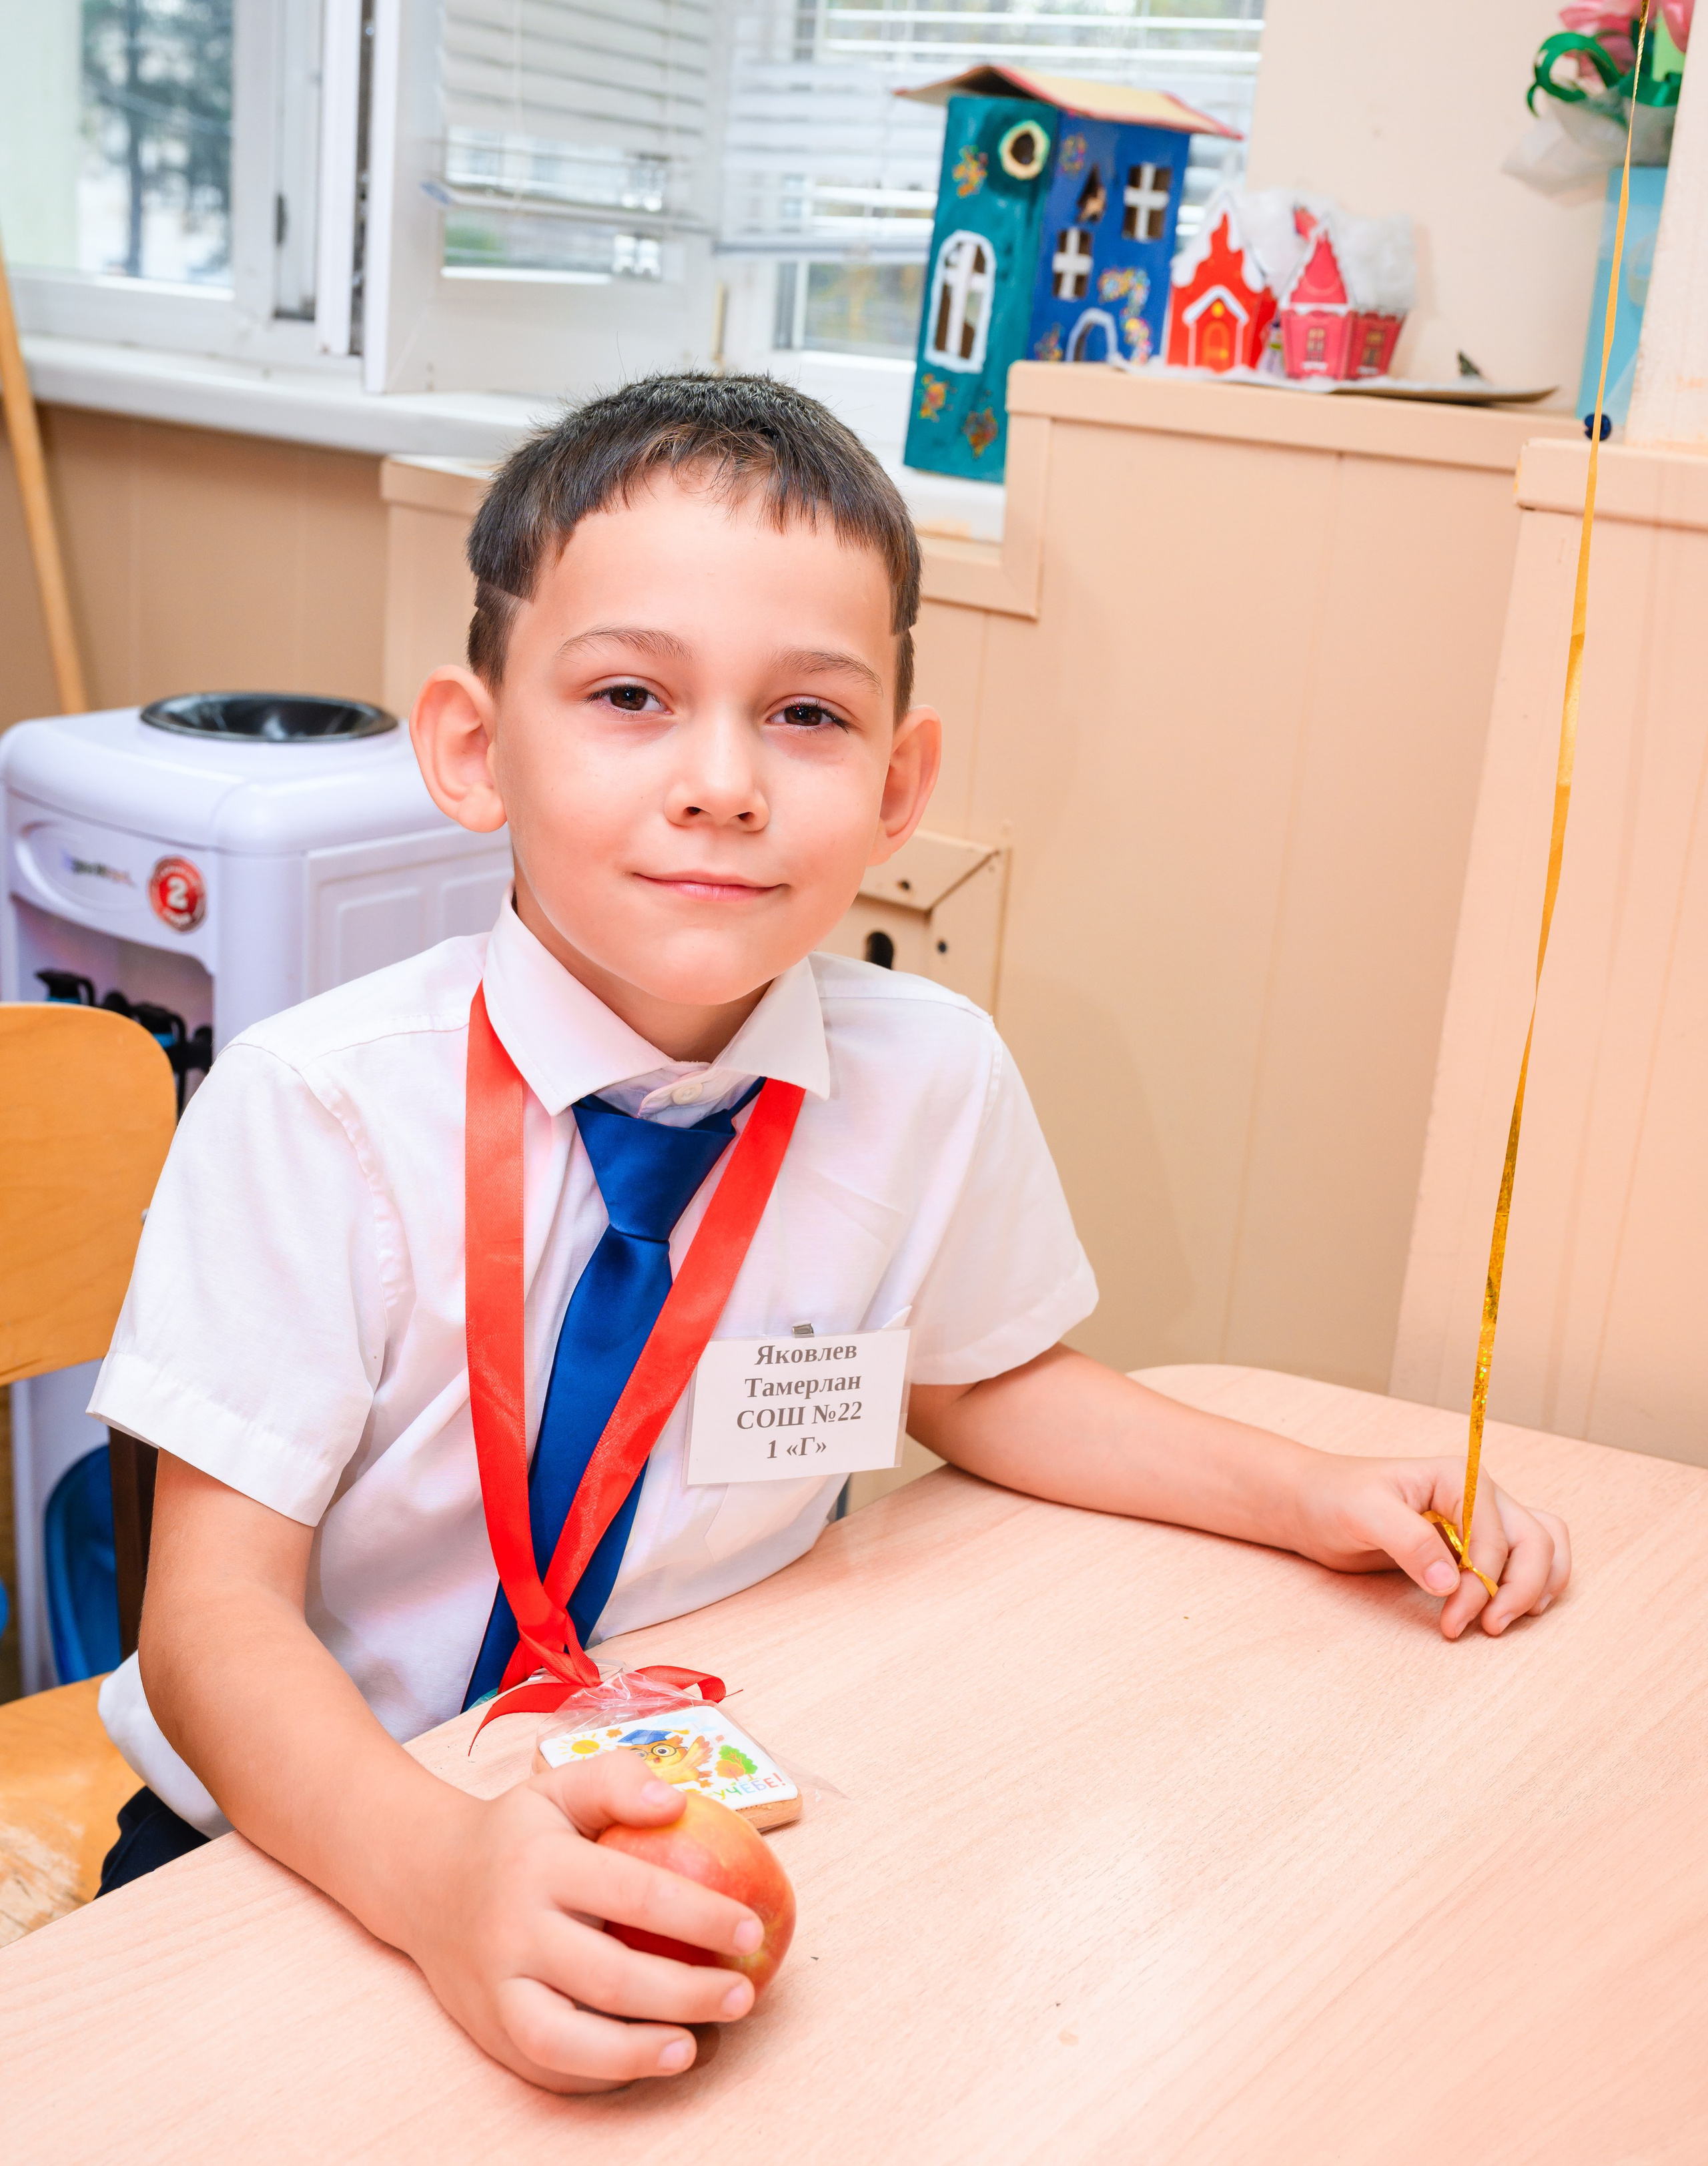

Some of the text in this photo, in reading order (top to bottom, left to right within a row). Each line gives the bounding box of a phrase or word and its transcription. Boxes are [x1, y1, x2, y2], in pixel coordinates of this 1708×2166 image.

[168, 877, 189, 910] 2
[754, 1344, 857, 1366] Яковлев
[744, 1375, 862, 1400] Тамерлан
[737, 1401, 863, 1429] СОШ №22
[767, 1437, 827, 1459] 1 «Г»
